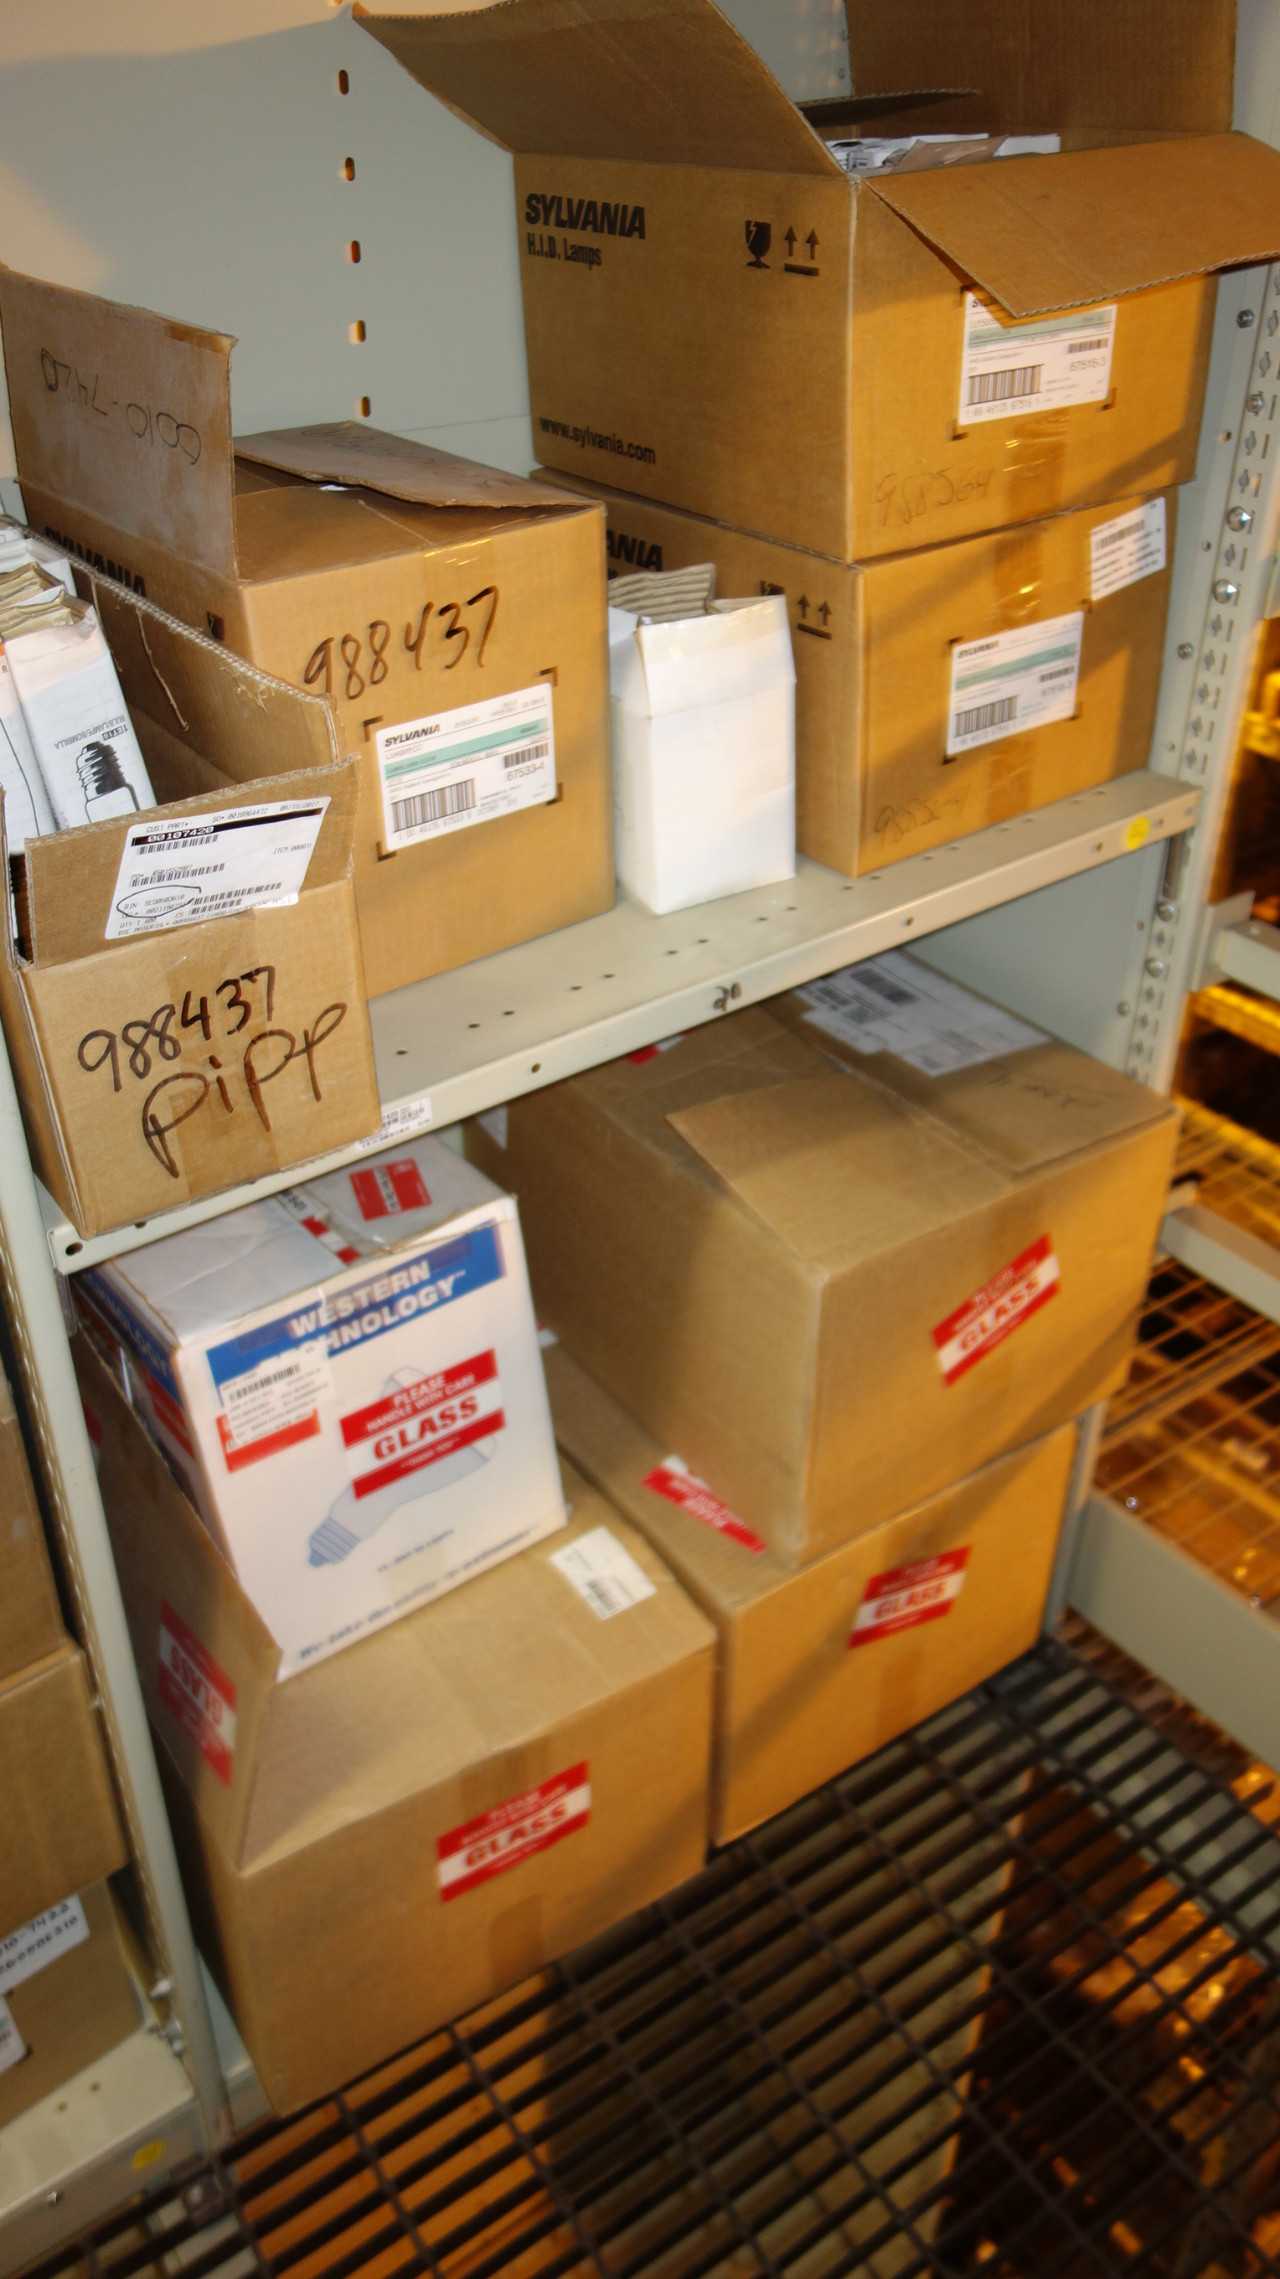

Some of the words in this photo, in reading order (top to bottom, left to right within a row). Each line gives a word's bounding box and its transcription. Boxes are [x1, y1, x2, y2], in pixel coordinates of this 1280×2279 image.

[525, 193, 646, 240] SYLVANIA
[527, 231, 561, 261] H.I.D.
[563, 237, 603, 271] Lamps
[539, 416, 657, 465] www.sylvania.com
[302, 584, 500, 701] 988437
[383, 723, 442, 748] SYLVANIA
[76, 964, 276, 1093] 988437
[286, 1260, 431, 1339] WESTERN
[957, 1278, 1037, 1352] GLASS
[391, 1376, 446, 1407] PLEASE
[372, 1394, 479, 1461] GLASS
[464, 1803, 568, 1868] GLASS
